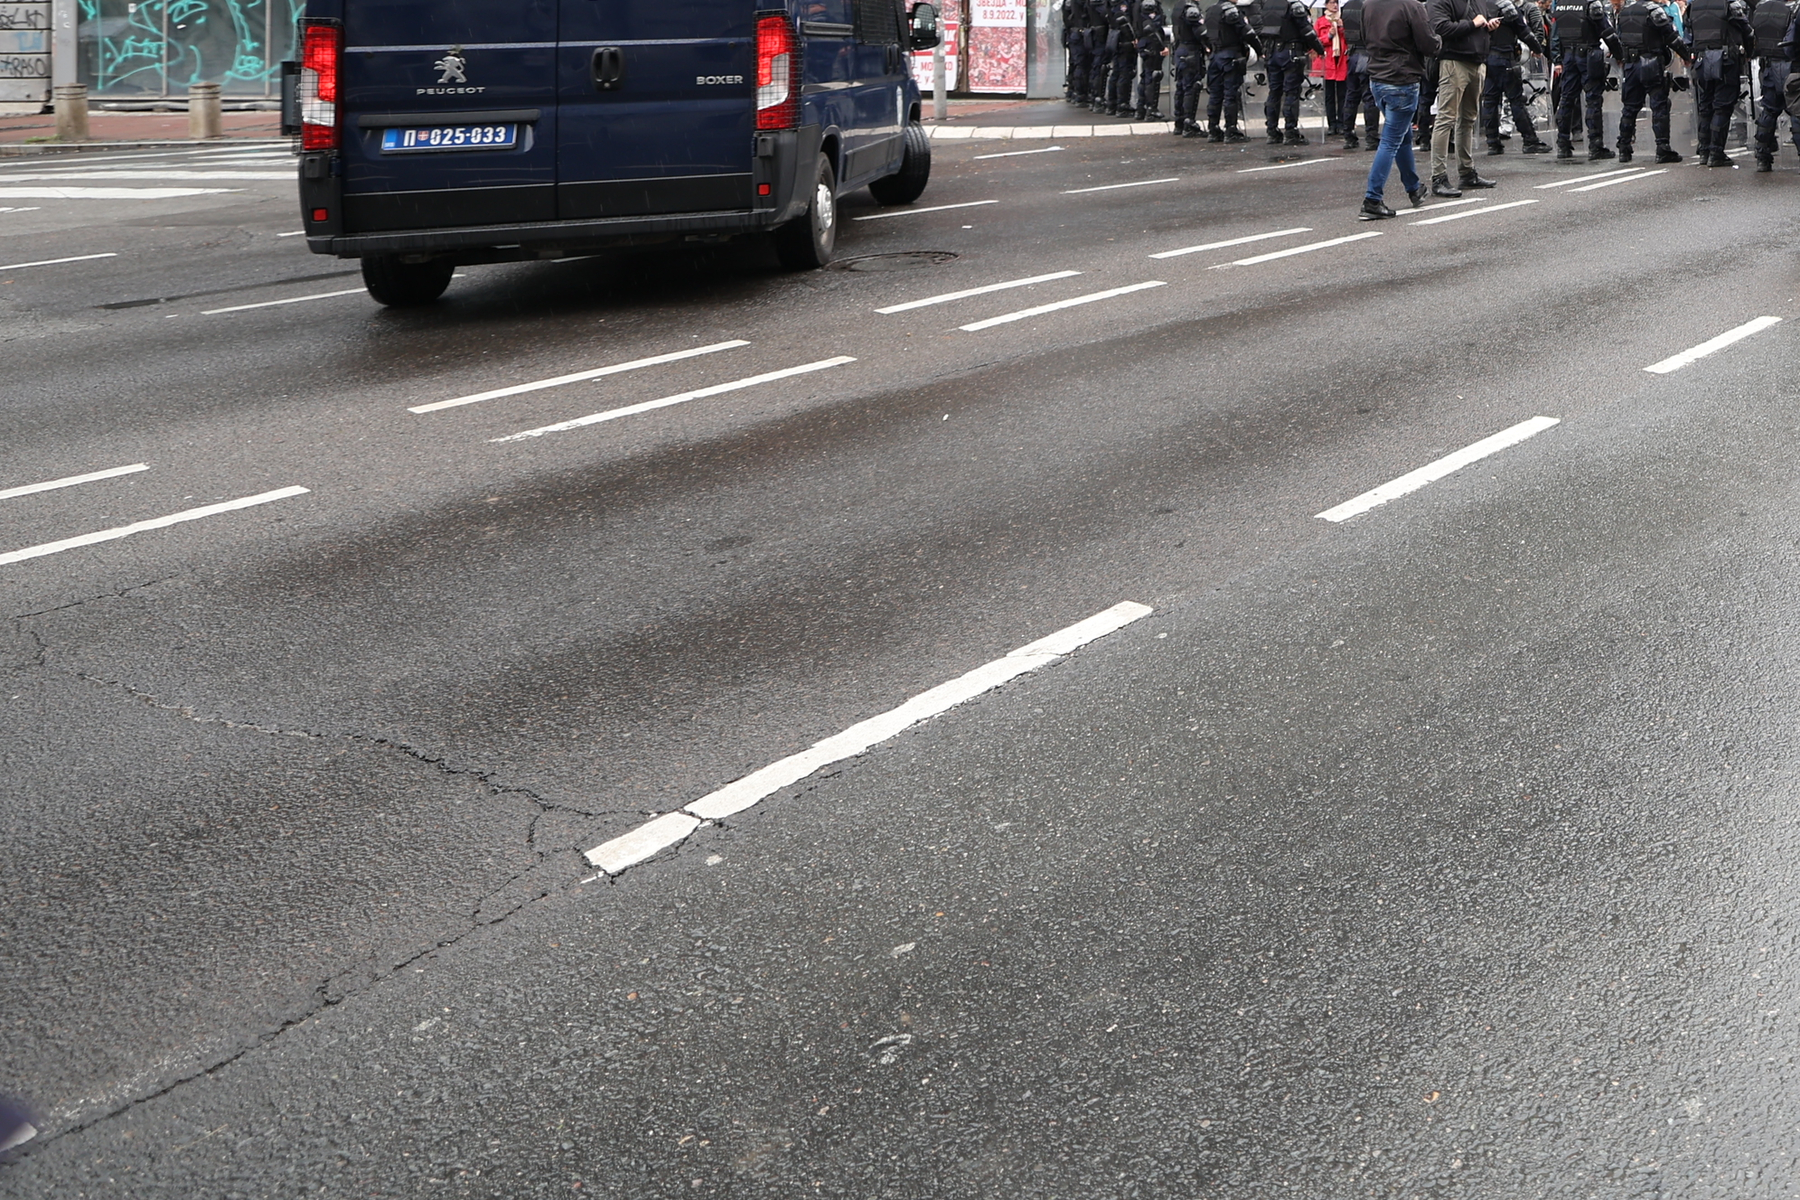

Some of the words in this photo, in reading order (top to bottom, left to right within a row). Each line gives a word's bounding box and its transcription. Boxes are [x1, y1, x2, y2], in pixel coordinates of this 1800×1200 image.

[982, 10, 1017, 20] 8.9.2022.
[695, 75, 744, 87] BOXER
[416, 85, 486, 96] PEUGEOT
